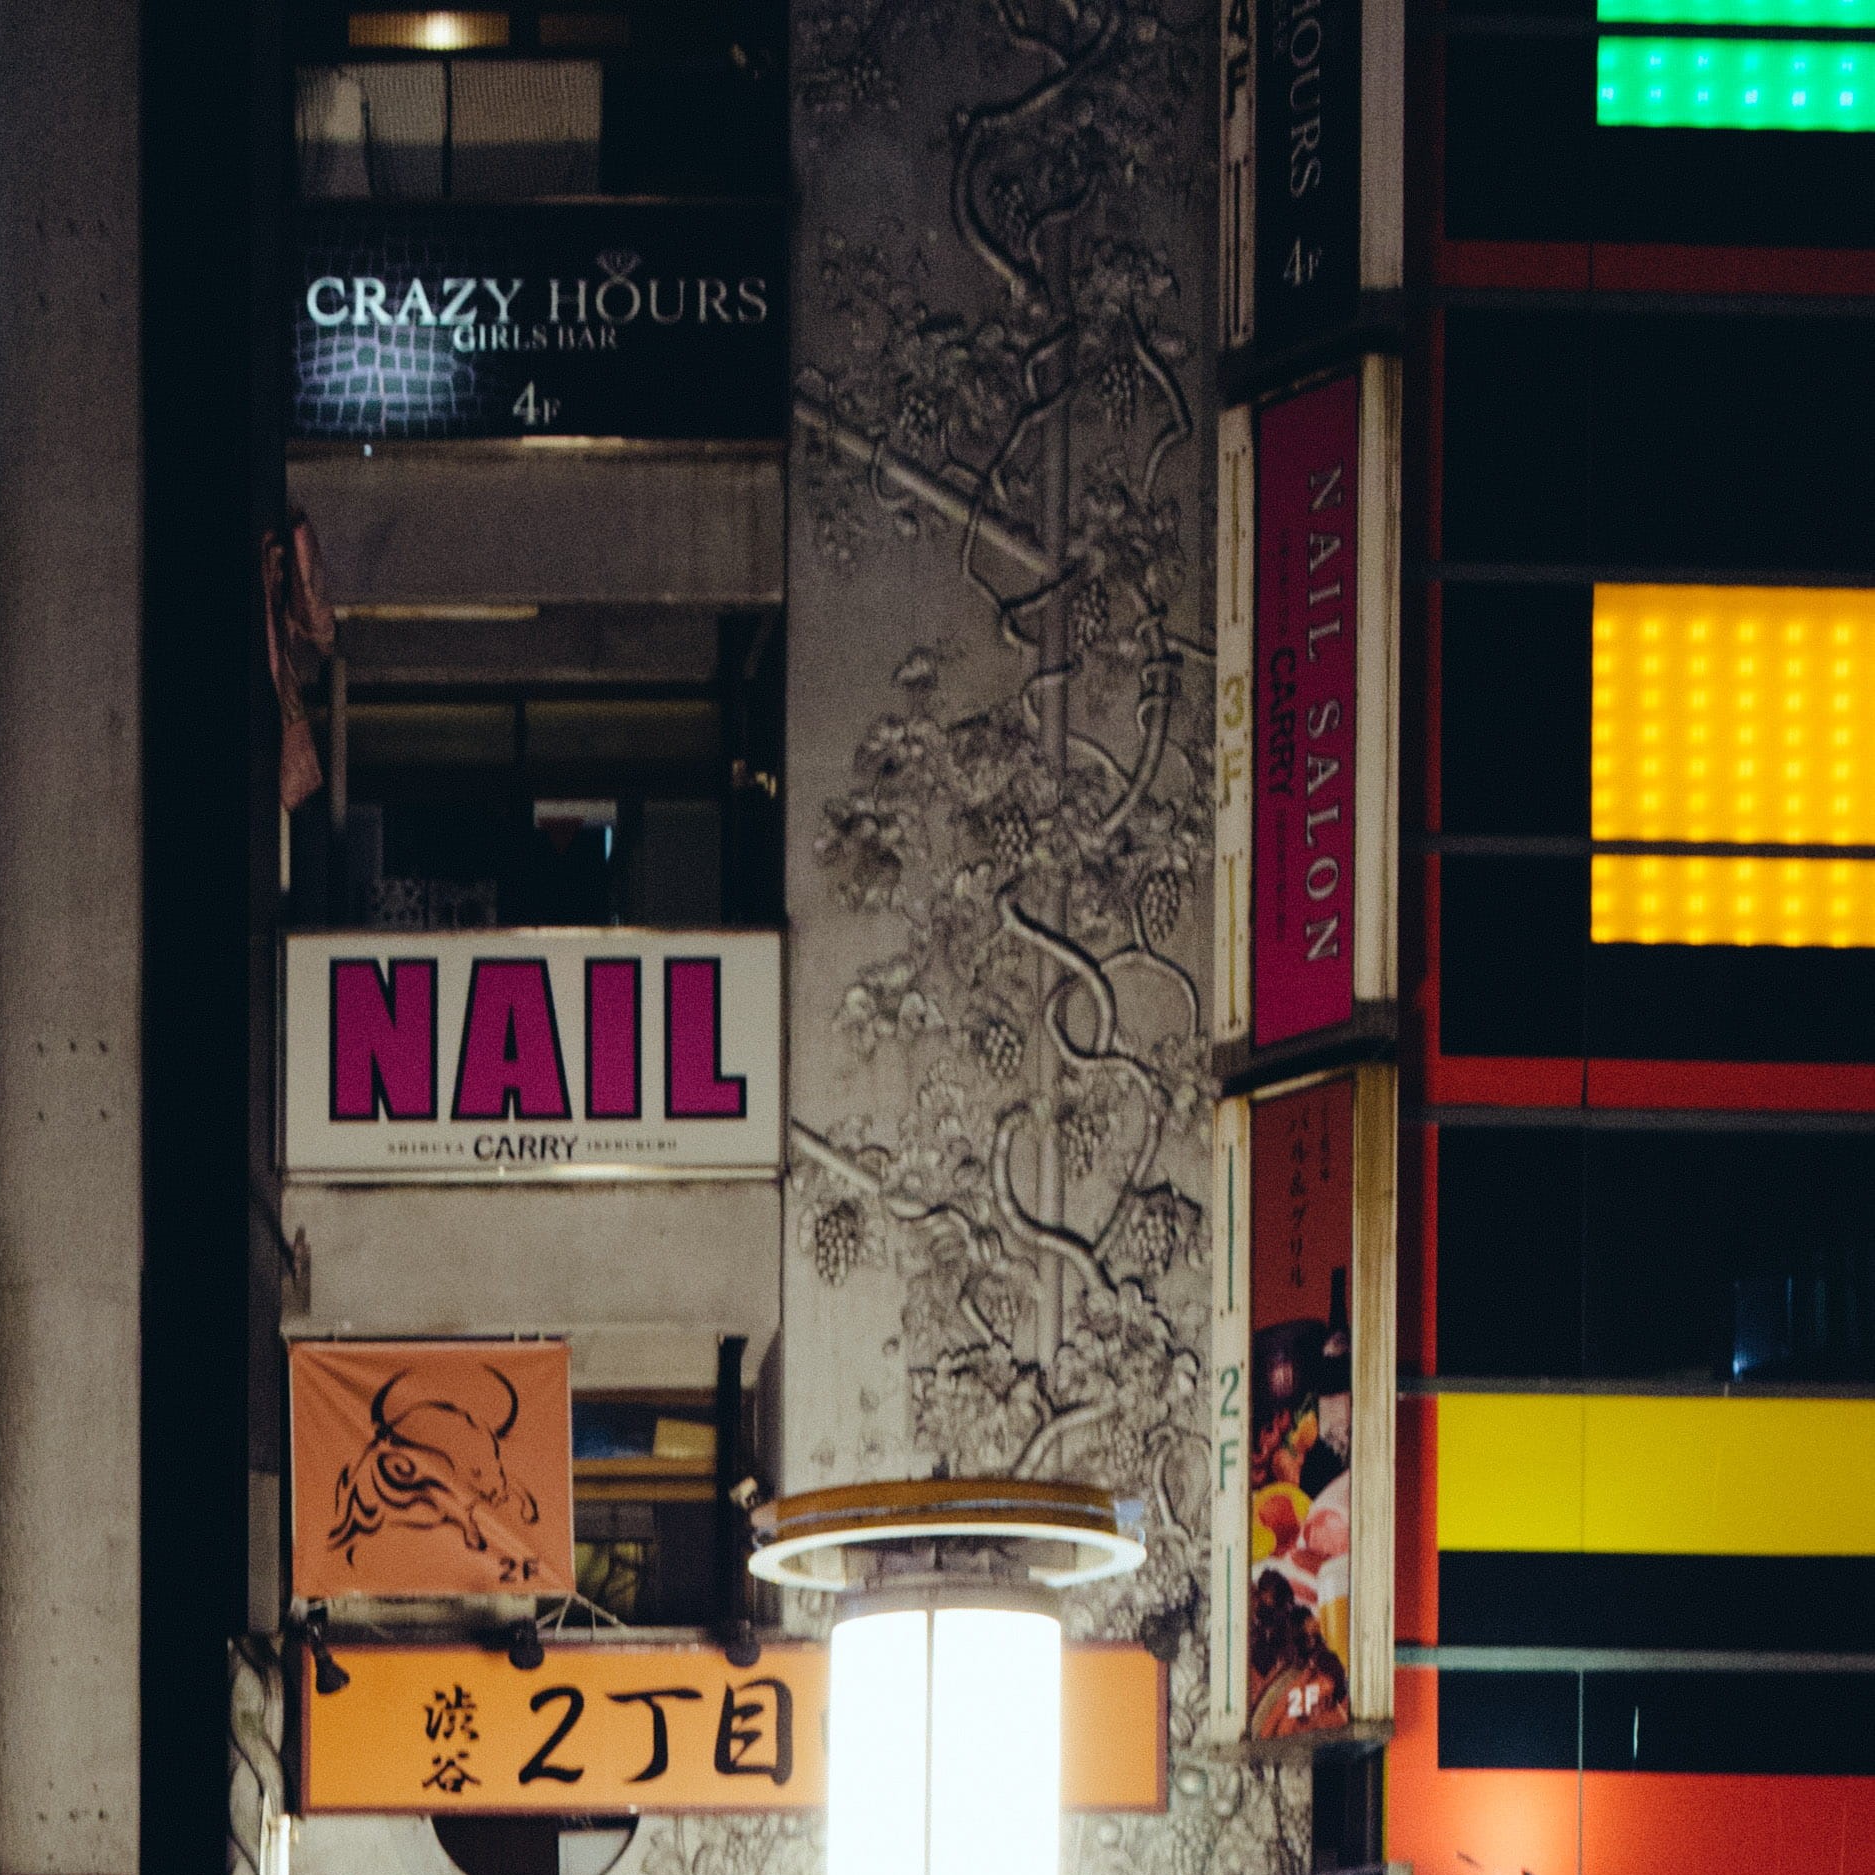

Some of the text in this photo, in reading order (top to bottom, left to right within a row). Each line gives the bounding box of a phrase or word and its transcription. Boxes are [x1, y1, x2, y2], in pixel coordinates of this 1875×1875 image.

[1289, 0, 1322, 199] OURS
[306, 275, 768, 327] CRAZY HOURS
[453, 324, 619, 353] GIRLS BAR
[512, 381, 561, 426] 4F
[1268, 647, 1297, 800] CARRY
[1304, 466, 1343, 963] NAIL SALON
[329, 956, 748, 1121] NAIL
[473, 1133, 580, 1162] CARRY
[1220, 1366, 1241, 1493] 2F
[498, 1557, 541, 1583] 2F
[423, 1684, 481, 1792] 渋谷
[518, 1679, 794, 1786] 2丁目
[1287, 1684, 1321, 1719] 2F
